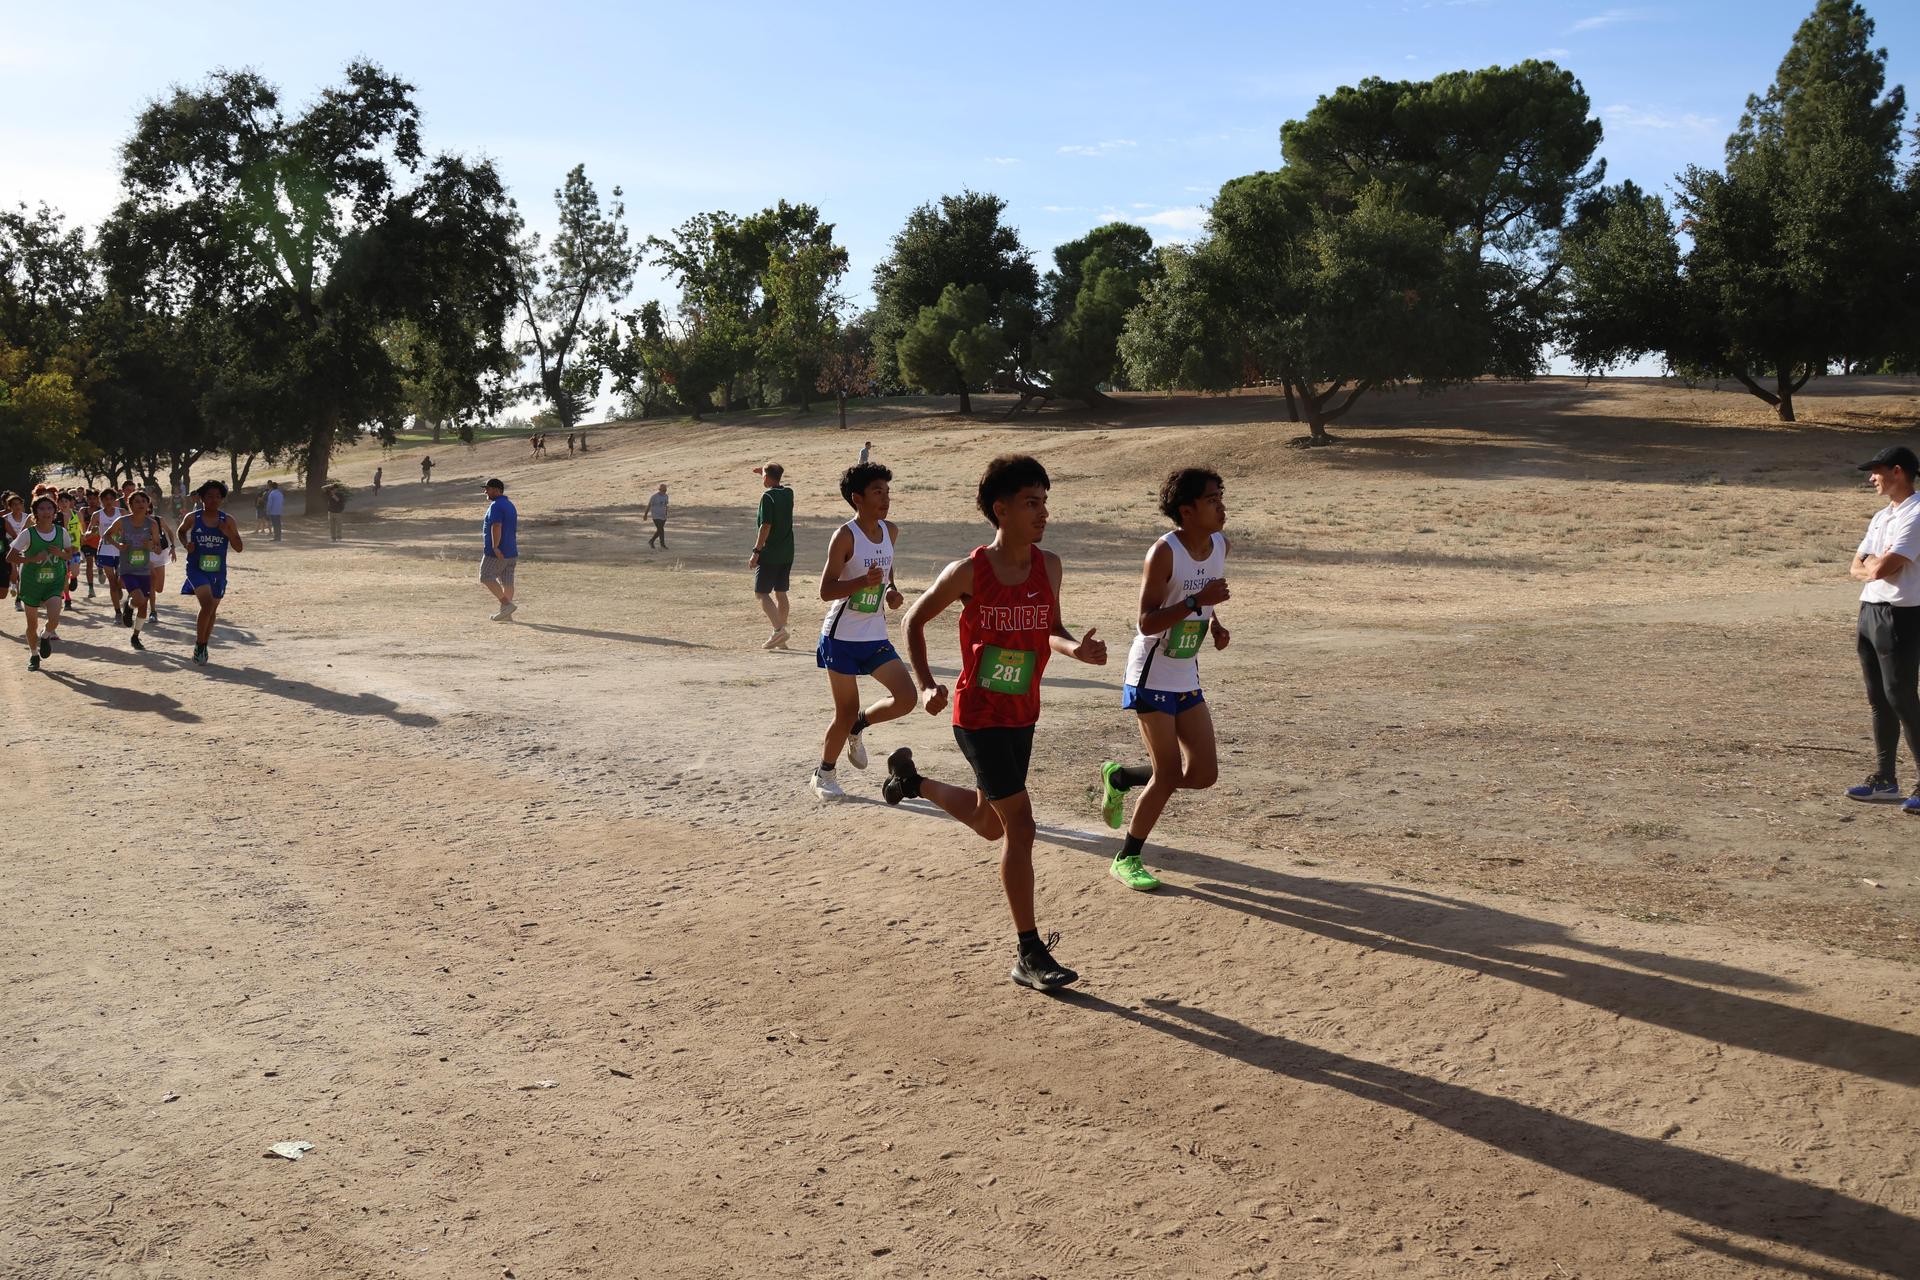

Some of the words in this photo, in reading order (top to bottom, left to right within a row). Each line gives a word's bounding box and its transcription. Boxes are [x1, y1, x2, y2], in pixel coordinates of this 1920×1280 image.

[196, 535, 224, 544] LOMPOC
[203, 560, 218, 568] 1217
[860, 593, 878, 605] 109
[979, 604, 1050, 631] TRIBE
[1178, 634, 1198, 648] 113
[992, 663, 1022, 683] 281
